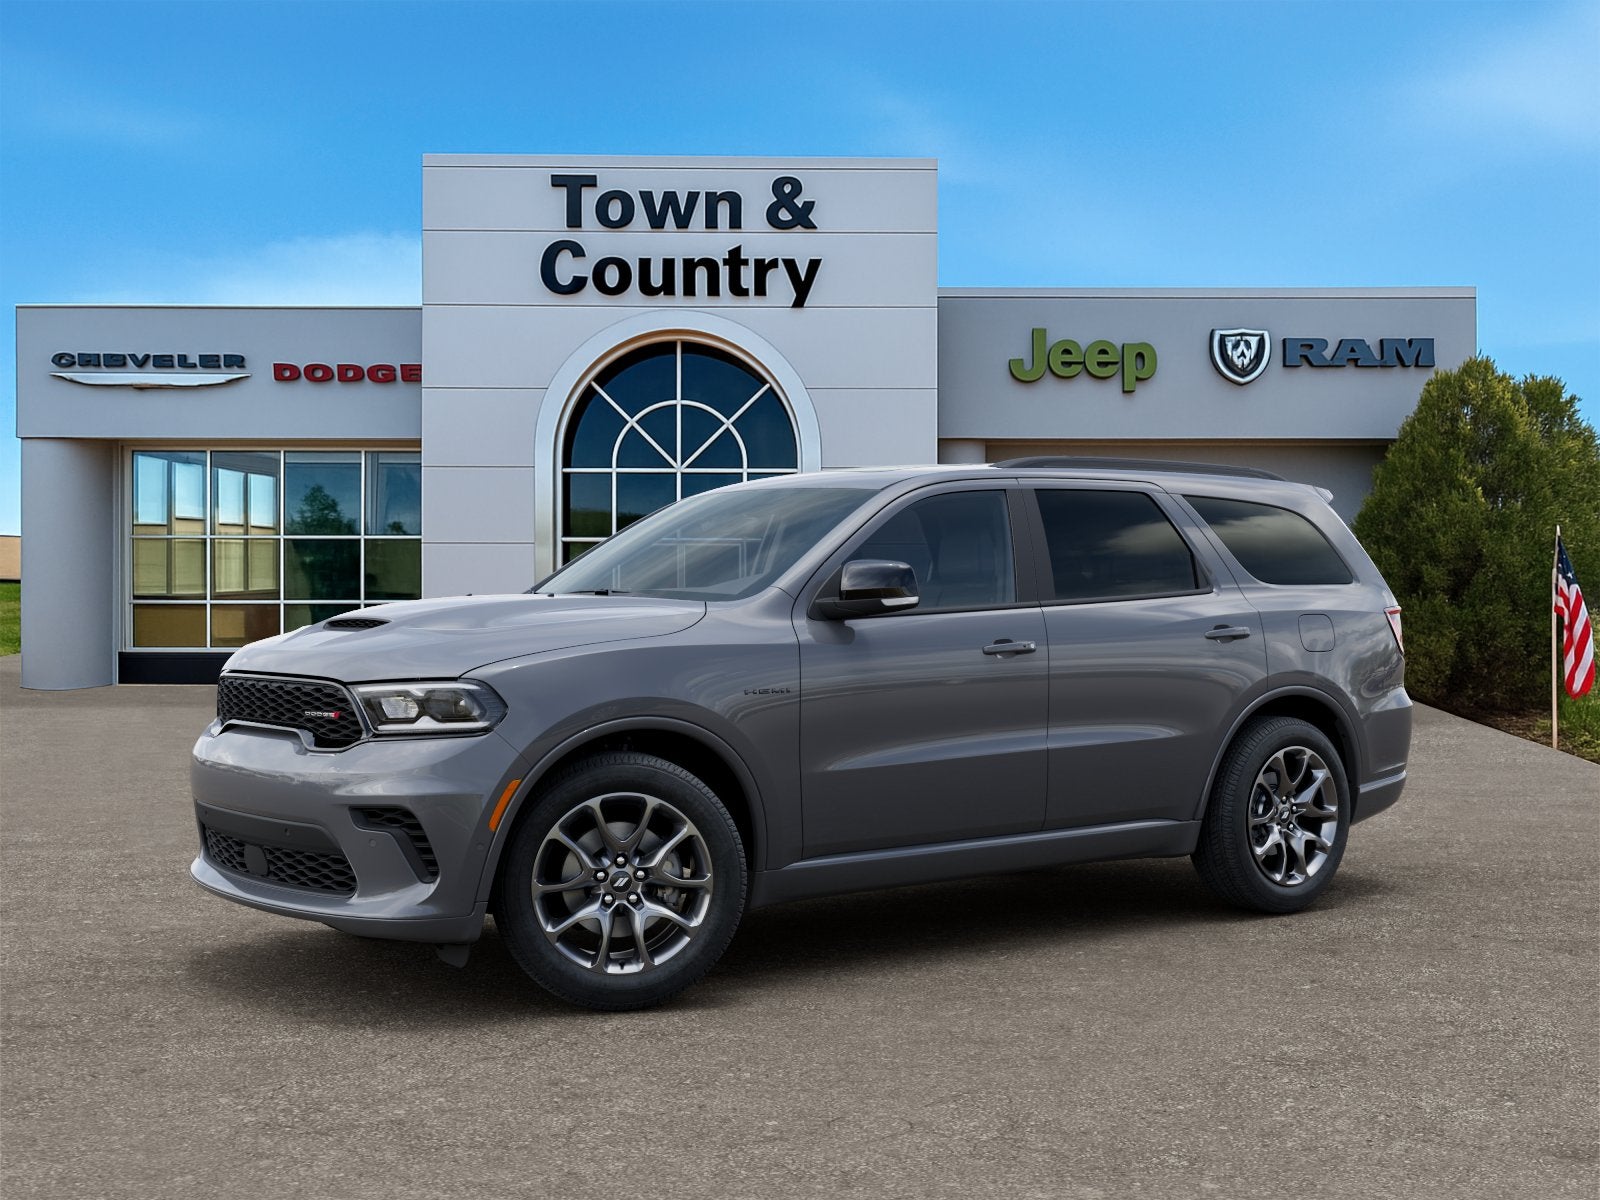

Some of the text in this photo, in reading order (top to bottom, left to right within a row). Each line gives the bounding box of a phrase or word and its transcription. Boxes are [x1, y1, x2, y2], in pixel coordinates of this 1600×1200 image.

[550, 174, 818, 230] Town &
[540, 239, 822, 308] Country
[273, 363, 422, 383] DODGE
[1009, 328, 1157, 392] Jeep
[1282, 337, 1435, 367] RAM
